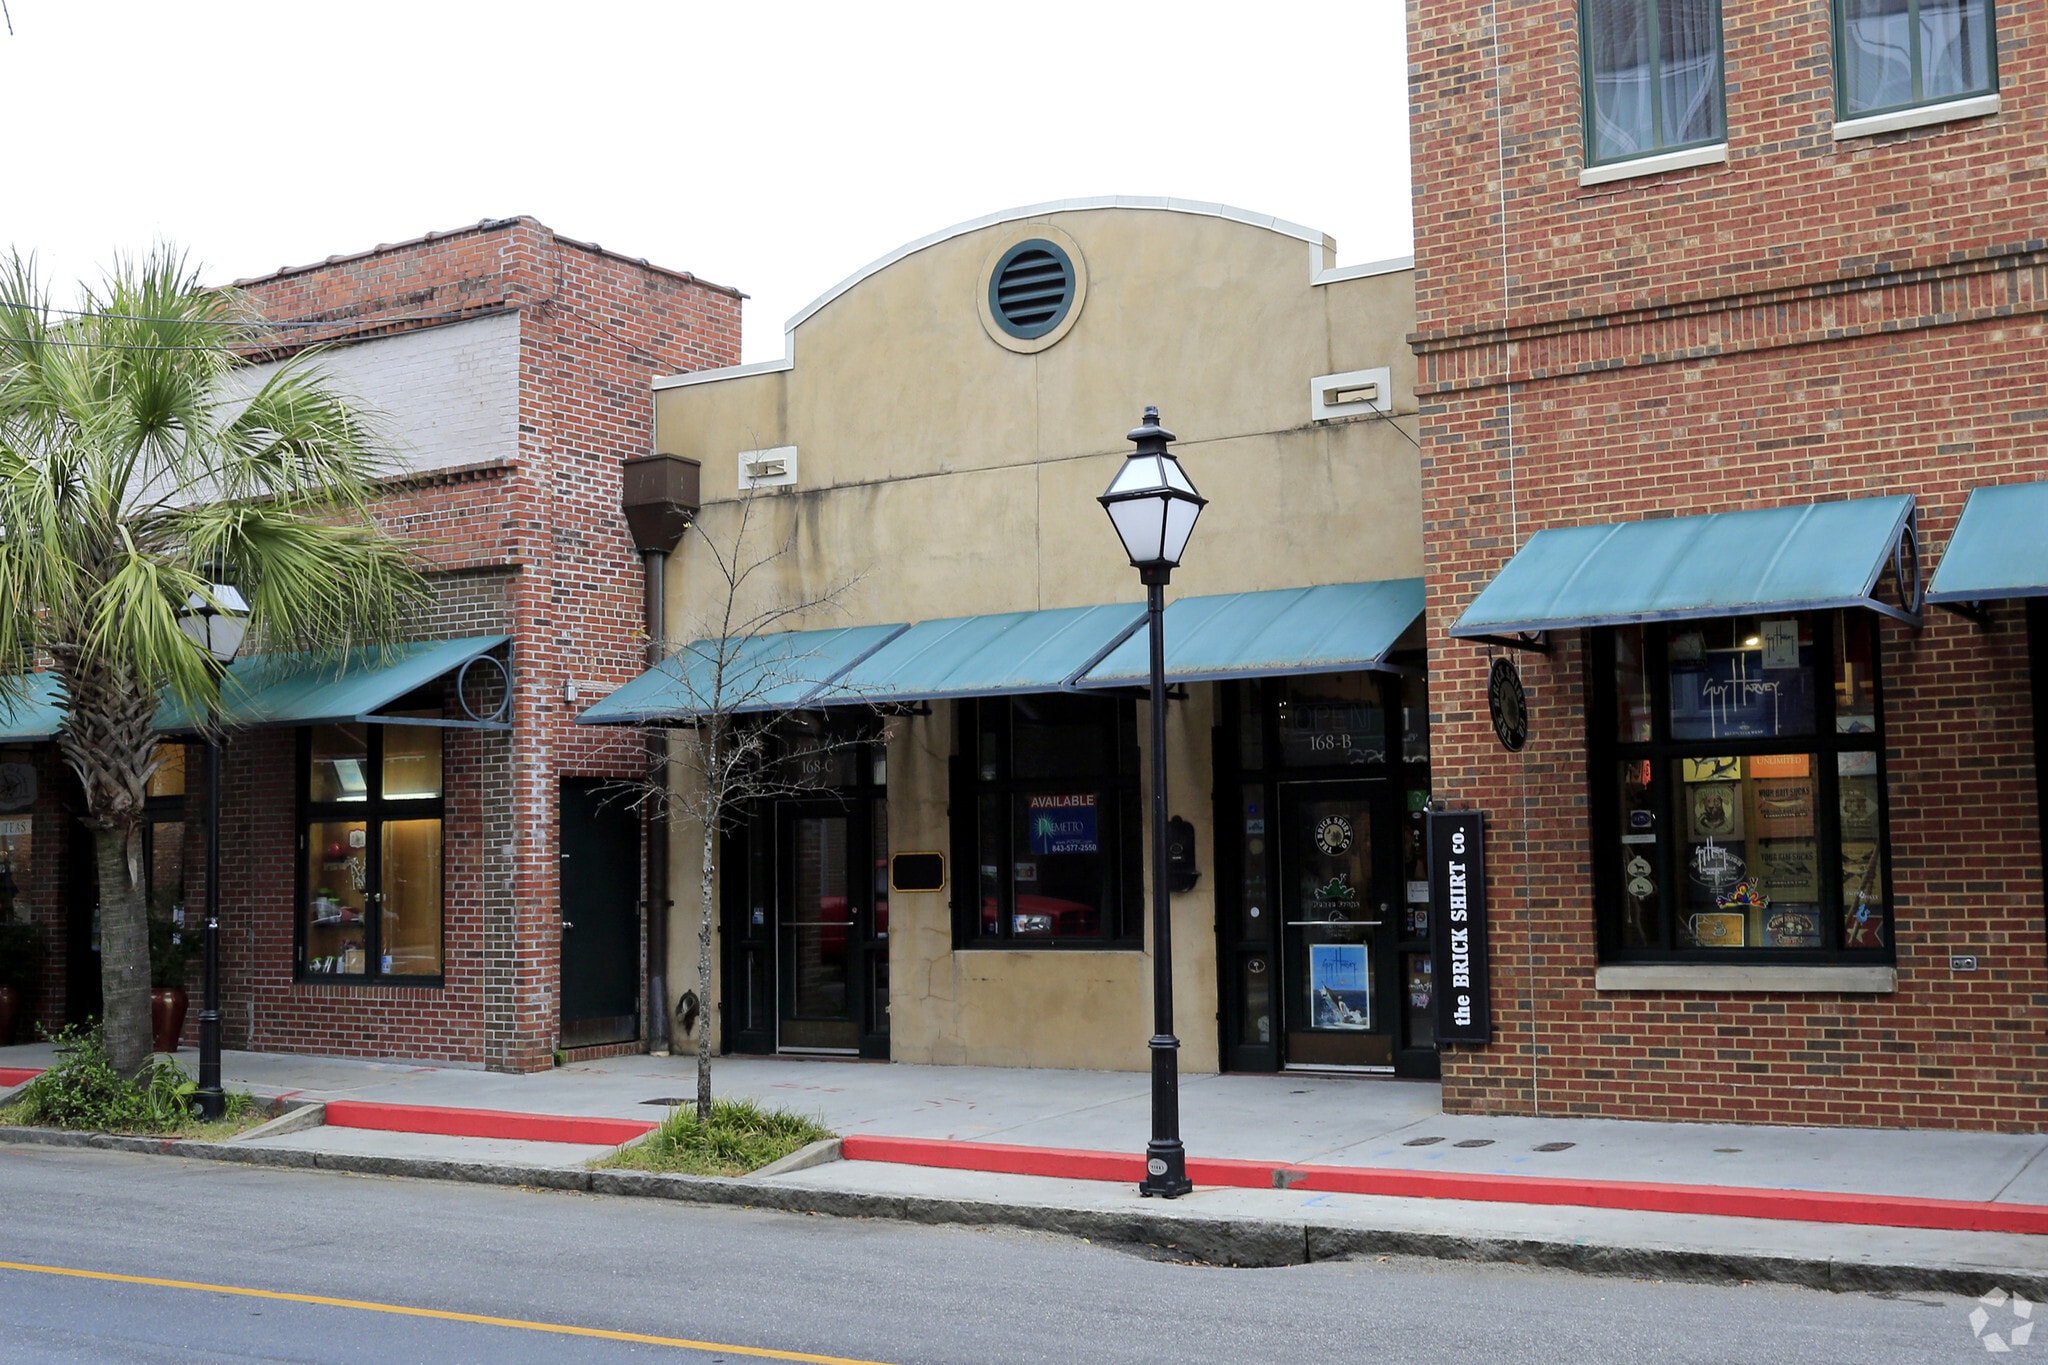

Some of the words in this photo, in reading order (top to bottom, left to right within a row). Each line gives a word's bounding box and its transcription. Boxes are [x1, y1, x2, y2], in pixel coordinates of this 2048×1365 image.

[1724, 652, 1780, 736] HARVEY
[1294, 702, 1370, 732] OPEN
[1310, 734, 1351, 751] 168-B
[802, 759, 834, 774] 168-C
[1756, 757, 1802, 765] UNLIMITED
[1031, 794, 1095, 808] AVAILABLE
[5, 821, 27, 833] TEAS
[1052, 843, 1097, 853] 843-577-2550
[1451, 826, 1466, 855] co.
[1449, 861, 1467, 922] SHIRT
[1451, 927, 1470, 988] BRICK
[1453, 994, 1471, 1027] the
